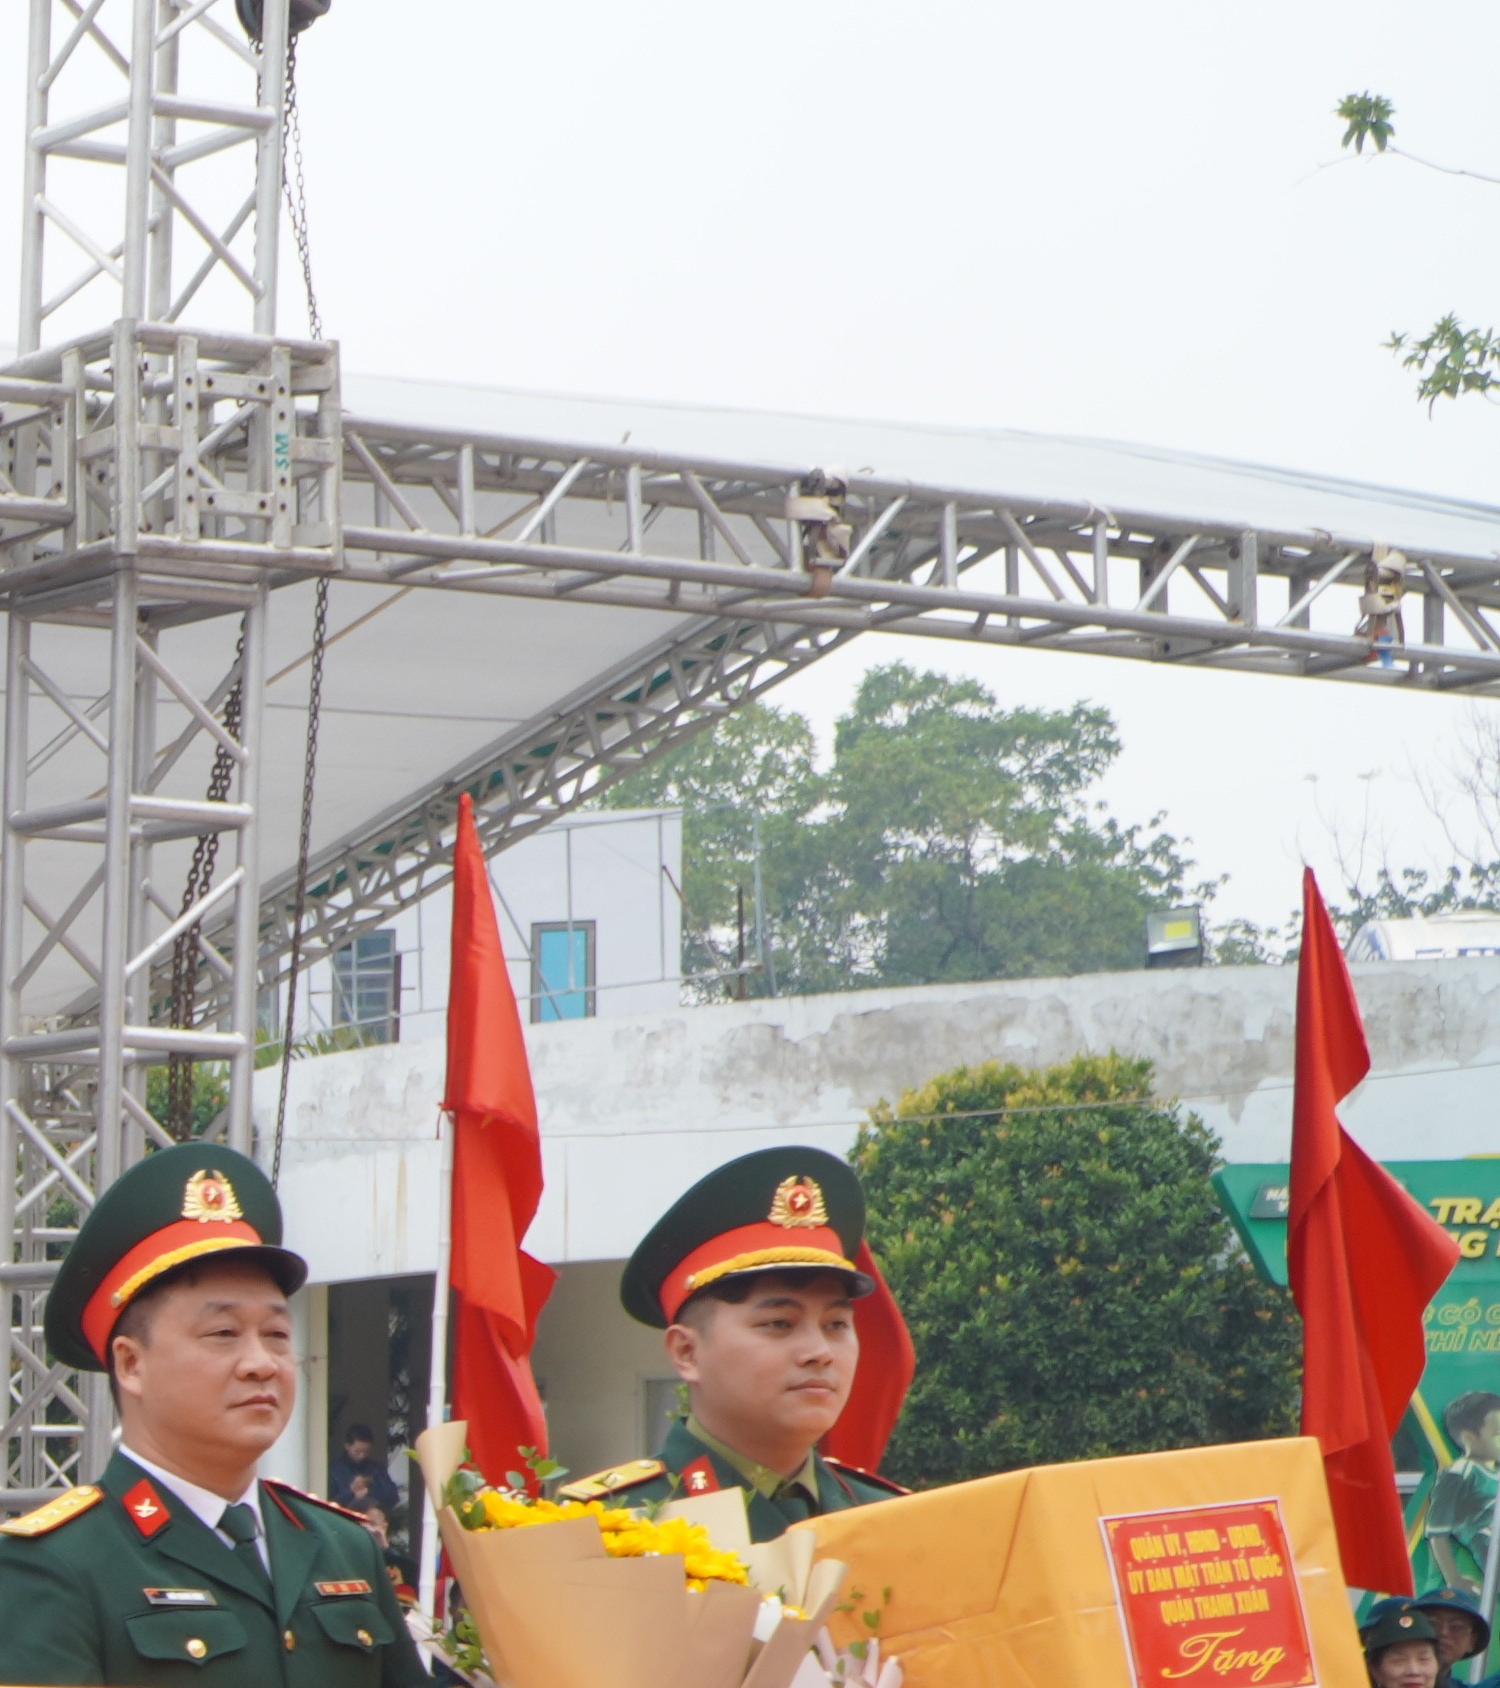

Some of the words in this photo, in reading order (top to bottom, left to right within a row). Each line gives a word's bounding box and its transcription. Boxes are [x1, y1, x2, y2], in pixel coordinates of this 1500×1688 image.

[1130, 1532, 1166, 1563] QUẬN
[1164, 1524, 1187, 1557] ỦY,
[1185, 1529, 1220, 1554] HĐND
[1227, 1524, 1265, 1549] UBND,
[1127, 1562, 1144, 1594] ỦY
[1146, 1568, 1174, 1592] BAN
[1173, 1560, 1200, 1592] MẶT
[1200, 1557, 1234, 1589] TRẬN
[1233, 1550, 1250, 1581] TỔ
[1250, 1548, 1283, 1581] QUỐC
[1160, 1595, 1195, 1627] QUẬN
[1195, 1594, 1235, 1619] THANH
[1235, 1585, 1269, 1614] XUÂN
[1162, 1627, 1285, 1682] Tặng
